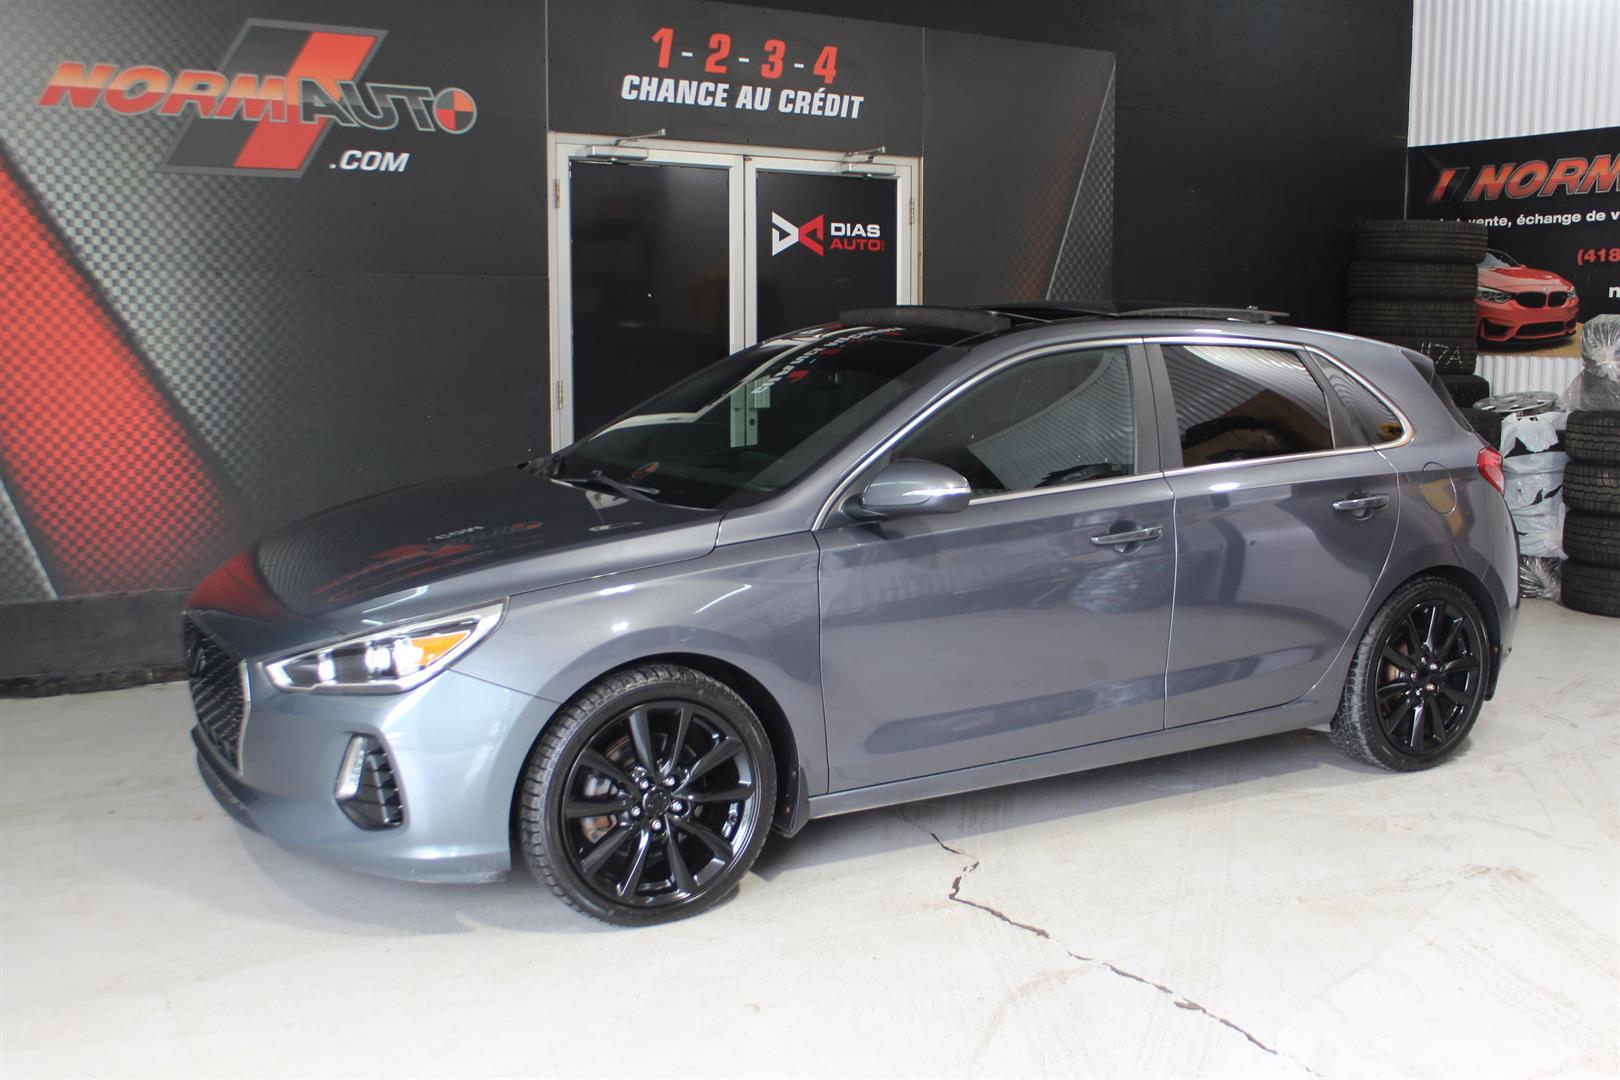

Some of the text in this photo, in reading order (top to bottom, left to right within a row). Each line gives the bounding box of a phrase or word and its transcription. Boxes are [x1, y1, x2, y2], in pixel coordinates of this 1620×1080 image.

[621, 74, 865, 119] CHANCE AU CRÉDIT
[329, 149, 410, 173] .COM
[1516, 212, 1582, 226] échange
[1586, 210, 1607, 222] de
[830, 222, 881, 238] DIAS
[830, 238, 882, 252] AUTO
